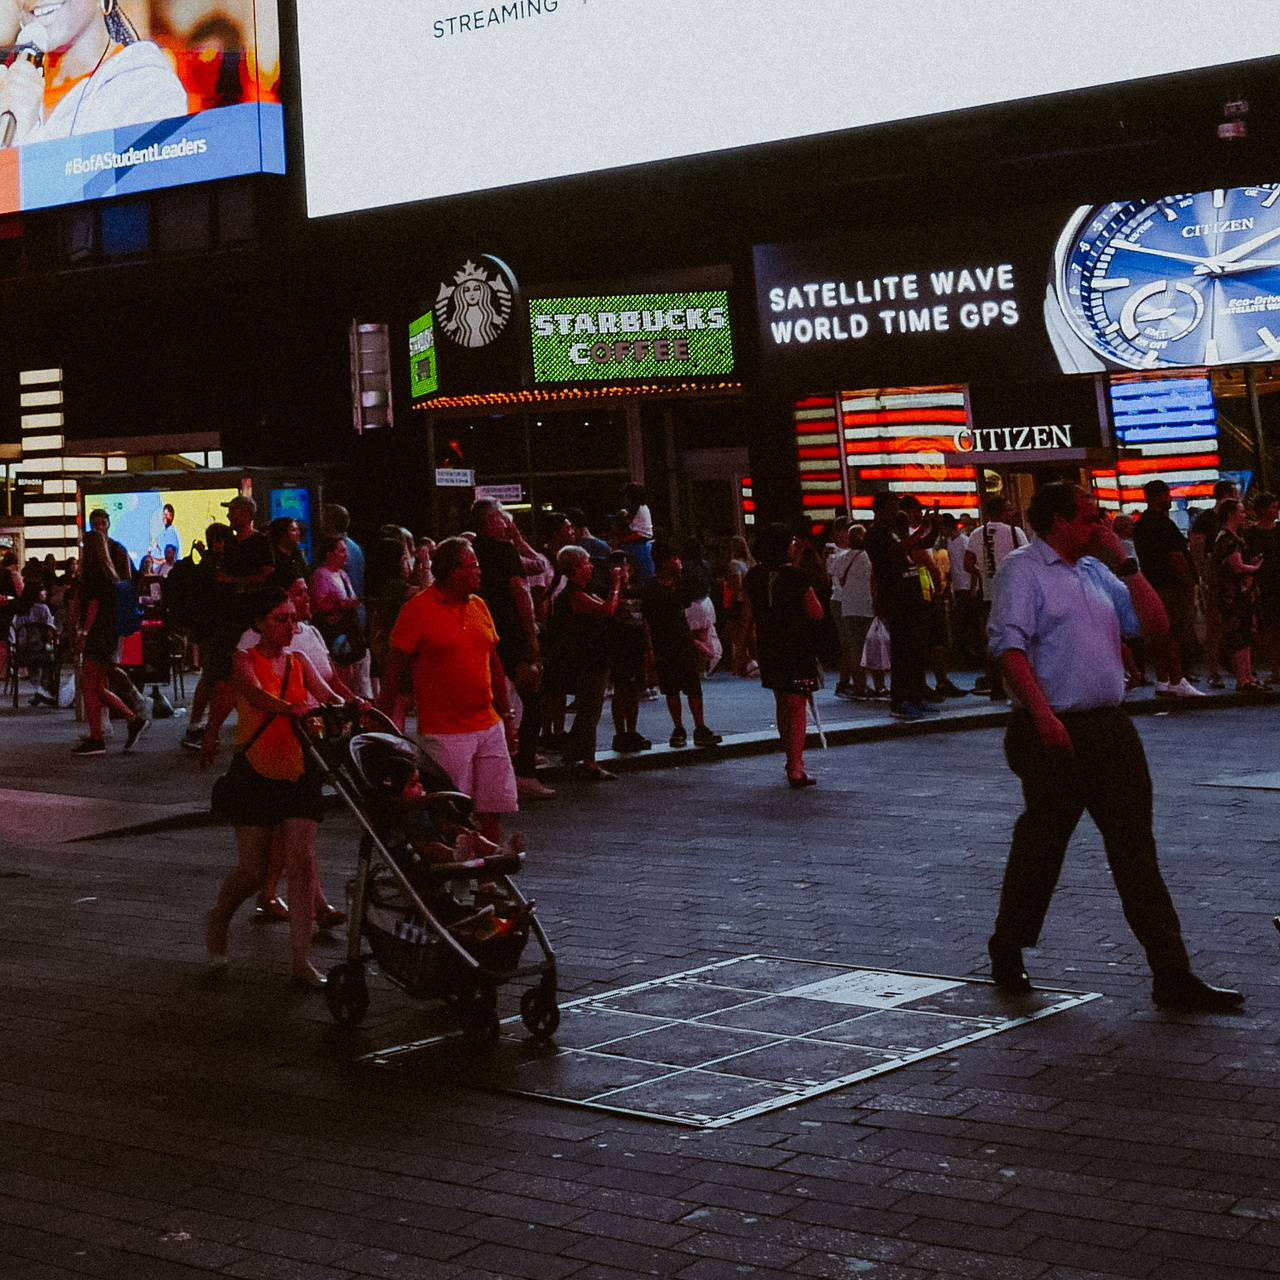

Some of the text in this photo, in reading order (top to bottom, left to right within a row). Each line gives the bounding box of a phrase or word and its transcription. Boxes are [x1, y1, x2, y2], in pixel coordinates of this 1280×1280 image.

[65, 138, 207, 175] #BofAStudentLeaders
[1182, 218, 1254, 238] CITIZEN
[769, 264, 1014, 312] SATELLITE WAVE
[534, 307, 723, 336] STARBUCKS
[770, 300, 1019, 344] WORLD TIME GPS
[569, 338, 689, 365] COFFEE
[953, 424, 1072, 453] CITIZEN
